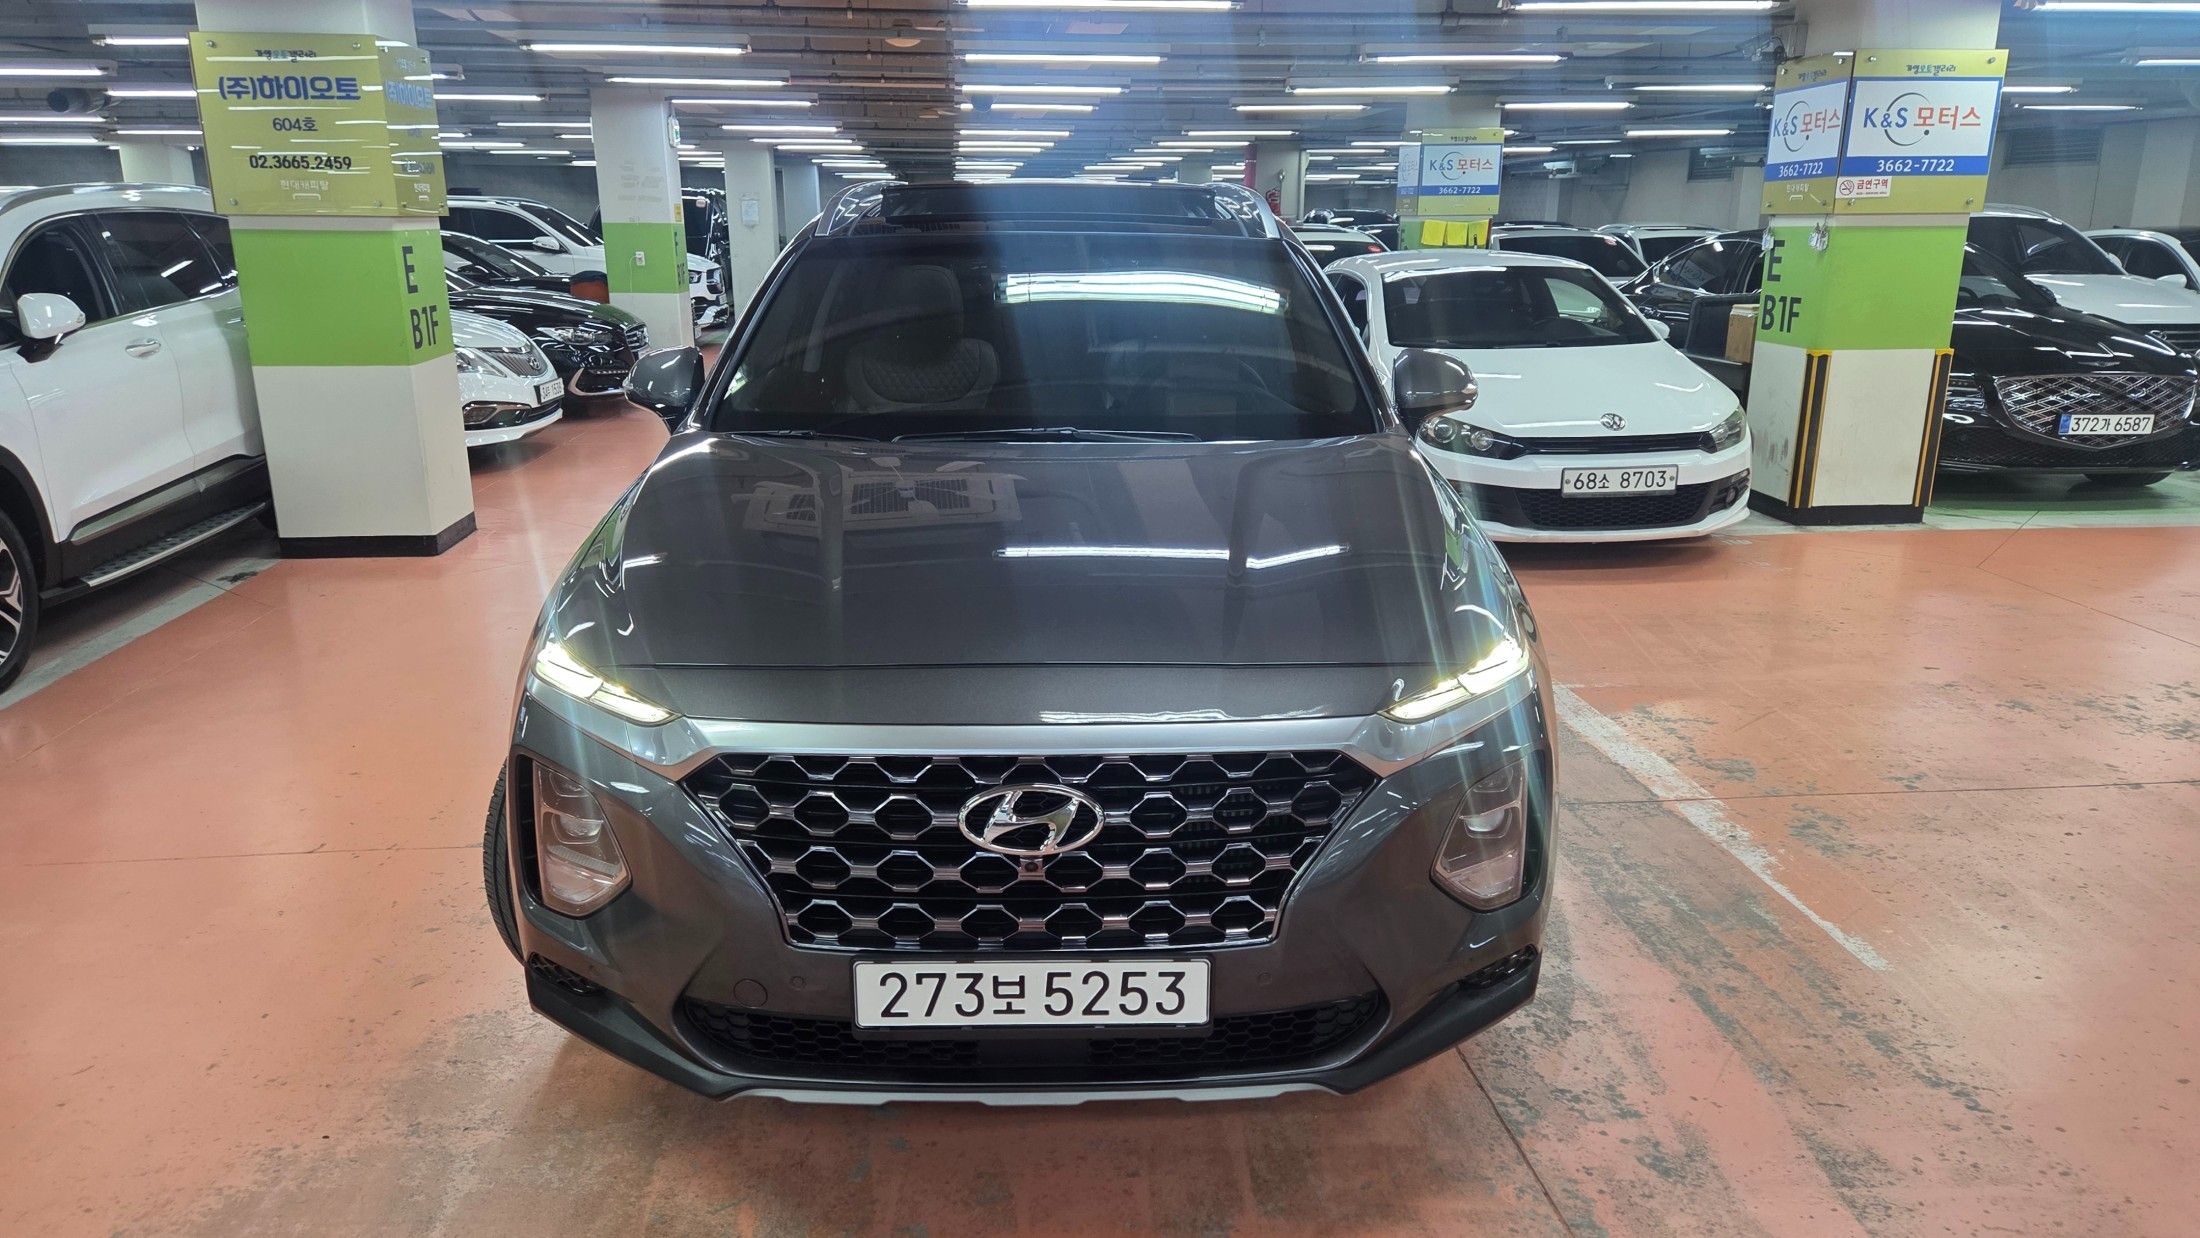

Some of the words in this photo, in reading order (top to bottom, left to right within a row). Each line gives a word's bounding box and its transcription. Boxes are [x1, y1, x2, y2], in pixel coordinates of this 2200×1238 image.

[218, 75, 362, 101] (주)하이오토
[272, 116, 319, 132] 604호
[1772, 114, 1799, 138] K&S
[1800, 108, 1841, 134] 모터스
[1863, 106, 1909, 129] K&S
[1913, 105, 1982, 131] 모터스
[249, 154, 352, 170] 02.3665.2459
[1429, 159, 1454, 172] K&S
[1456, 158, 1494, 172] 모터스
[1778, 160, 1824, 178] 3662-7722
[1876, 158, 1955, 173] 3662-7722
[1438, 186, 1481, 195] 3662-7722
[1856, 178, 1889, 191] 금연구역
[402, 246, 419, 294] E
[1766, 239, 1786, 282] E
[1761, 294, 1802, 334] B1F
[410, 304, 439, 350] B1F
[2071, 417, 2111, 432] 372가
[2113, 416, 2151, 432] 6587
[1573, 472, 1610, 490] 68소
[1619, 470, 1667, 489] 8703
[879, 971, 1026, 1019] 273보
[1043, 970, 1187, 1017] 5253
